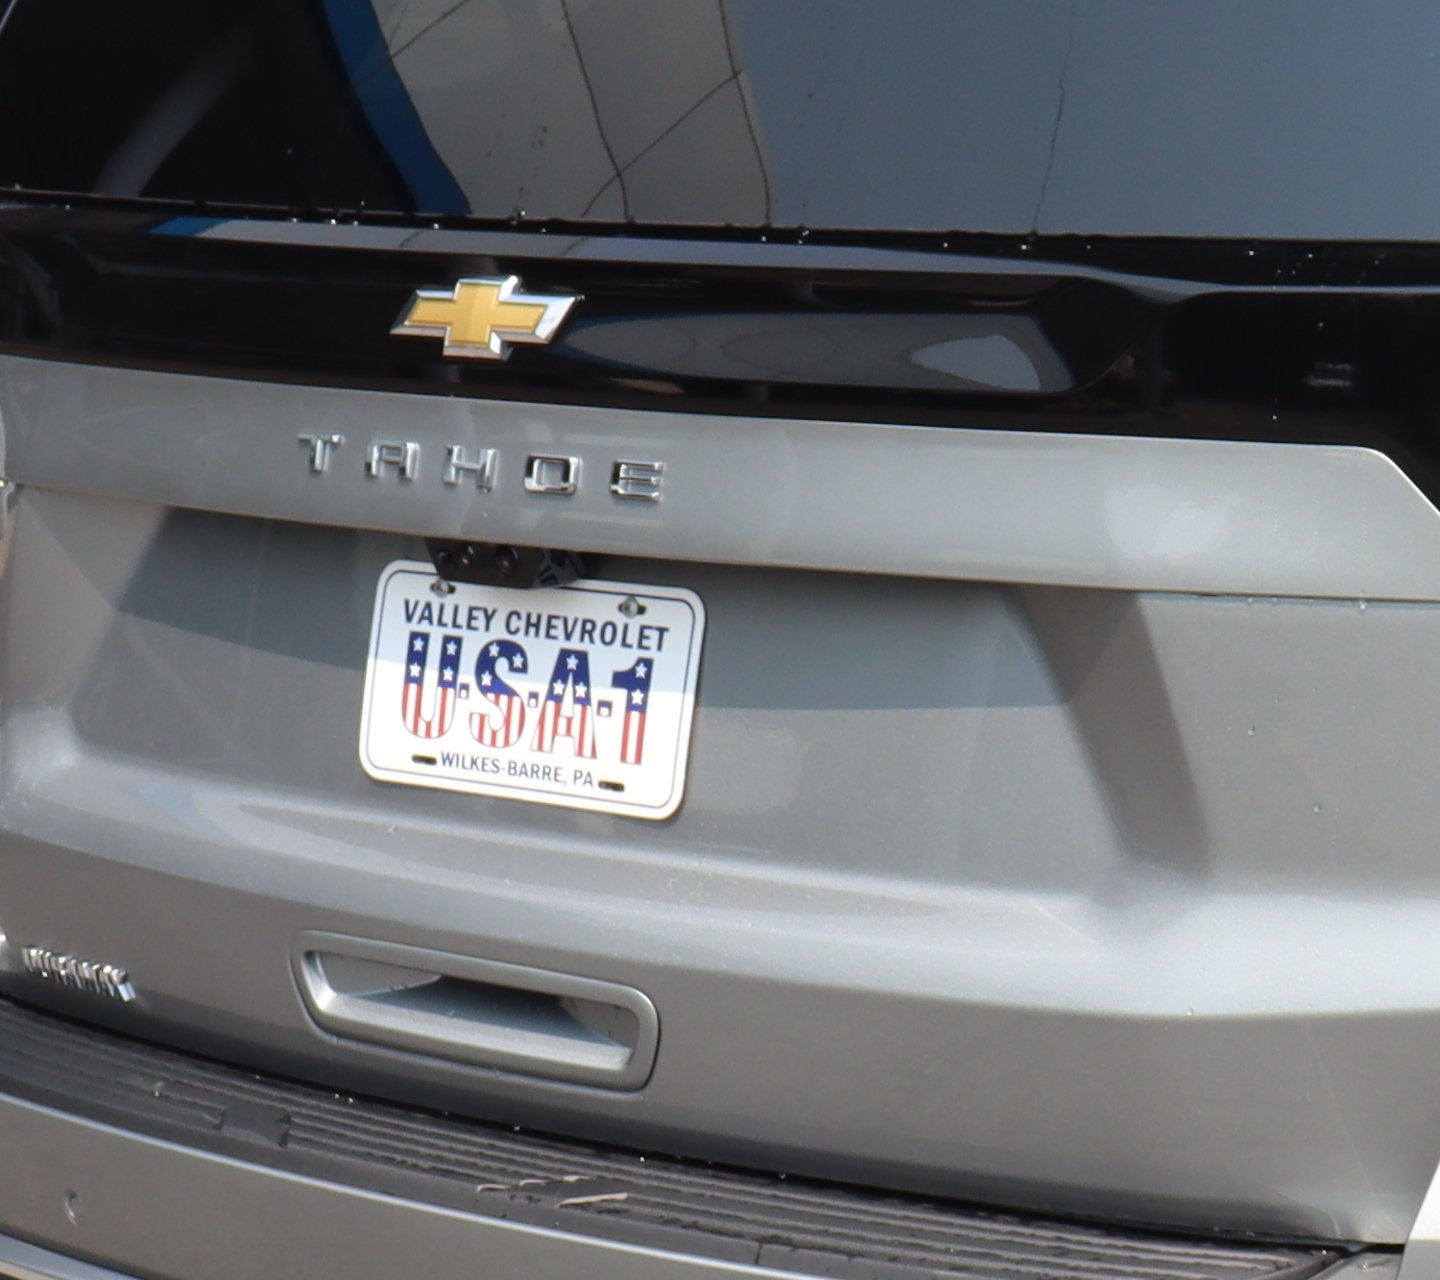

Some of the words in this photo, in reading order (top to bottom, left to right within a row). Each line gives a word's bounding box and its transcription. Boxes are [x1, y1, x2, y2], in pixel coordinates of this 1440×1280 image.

[297, 433, 664, 502] TAHOE
[403, 598, 498, 632] VALLEY
[505, 609, 670, 652] CHEVROLET
[440, 751, 567, 786] WILKES-BARRE,
[572, 769, 594, 788] PA
